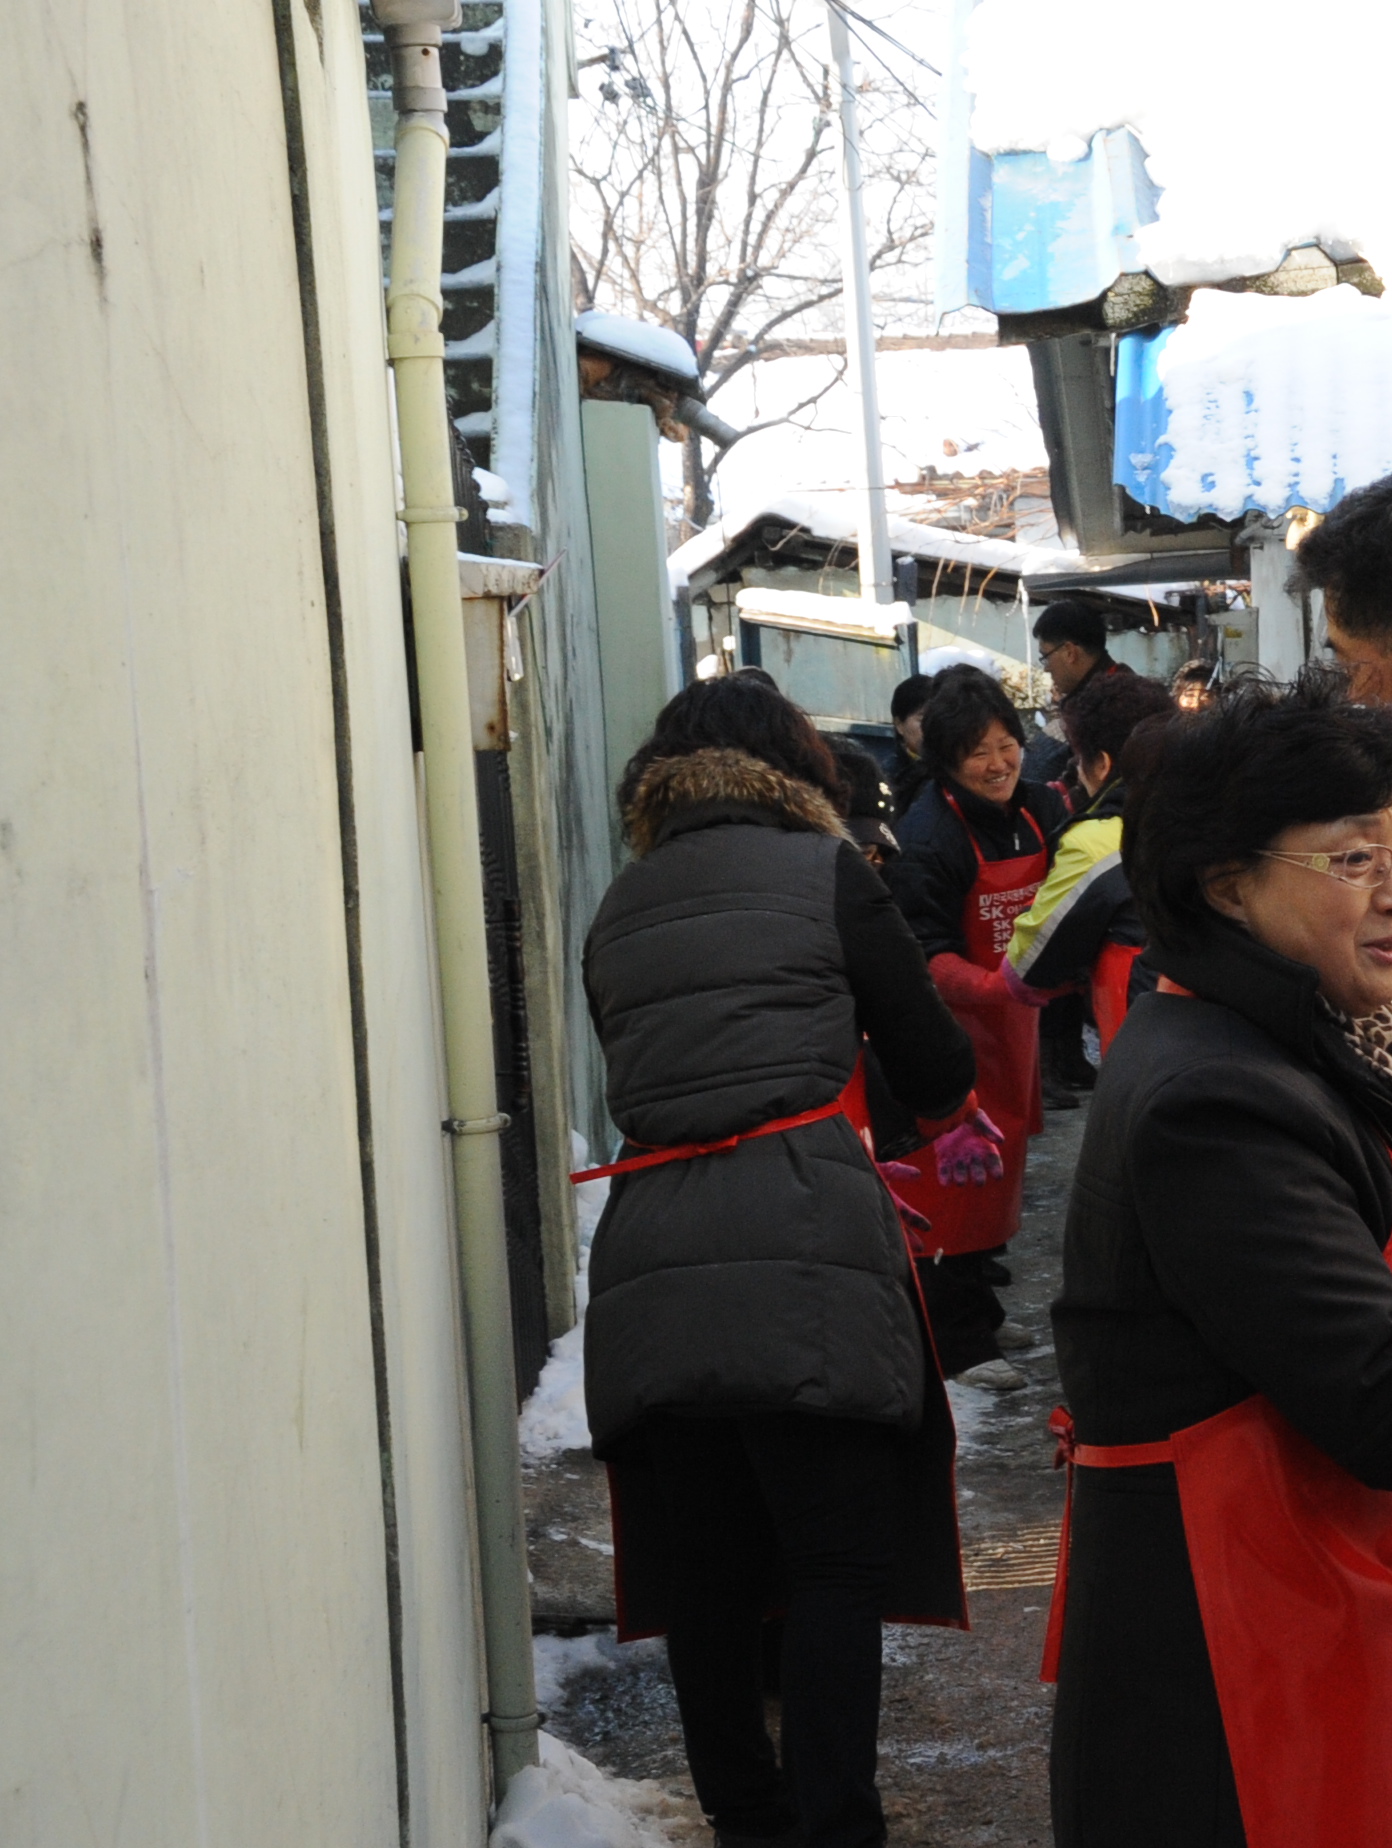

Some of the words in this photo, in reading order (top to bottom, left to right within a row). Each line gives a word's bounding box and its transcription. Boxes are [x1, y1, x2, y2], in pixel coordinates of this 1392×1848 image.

[979, 906, 1004, 920] SK
[993, 919, 1011, 931] SK
[993, 930, 1011, 941] SK
